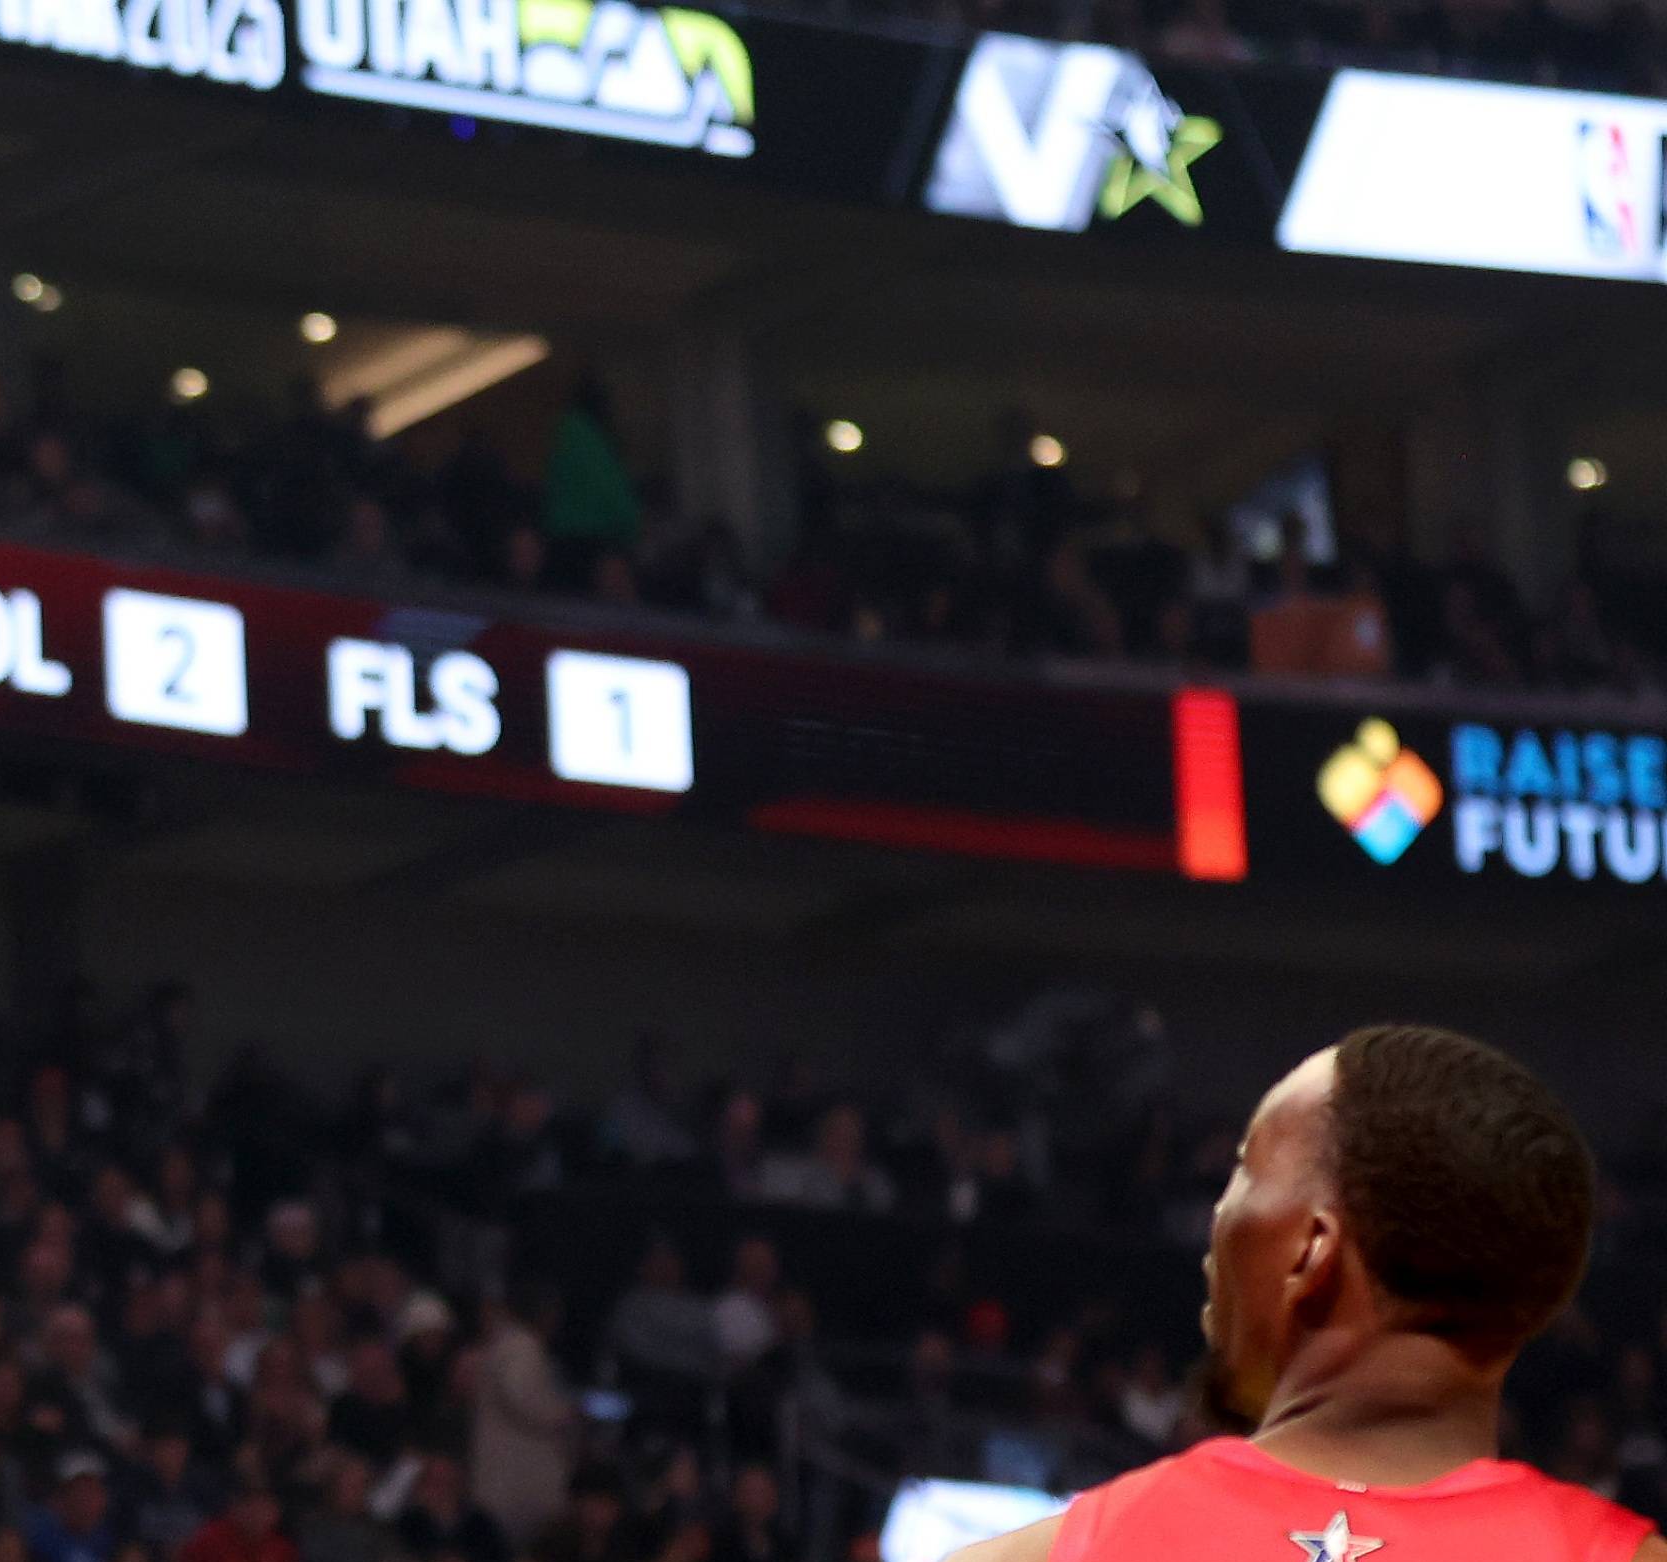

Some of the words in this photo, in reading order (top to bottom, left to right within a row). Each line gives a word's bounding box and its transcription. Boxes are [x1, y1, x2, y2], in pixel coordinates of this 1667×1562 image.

[151, 618, 199, 708] 2
[324, 636, 503, 756] FLS
[1449, 720, 1667, 807] RAISE
[1453, 795, 1667, 884] FUTU
